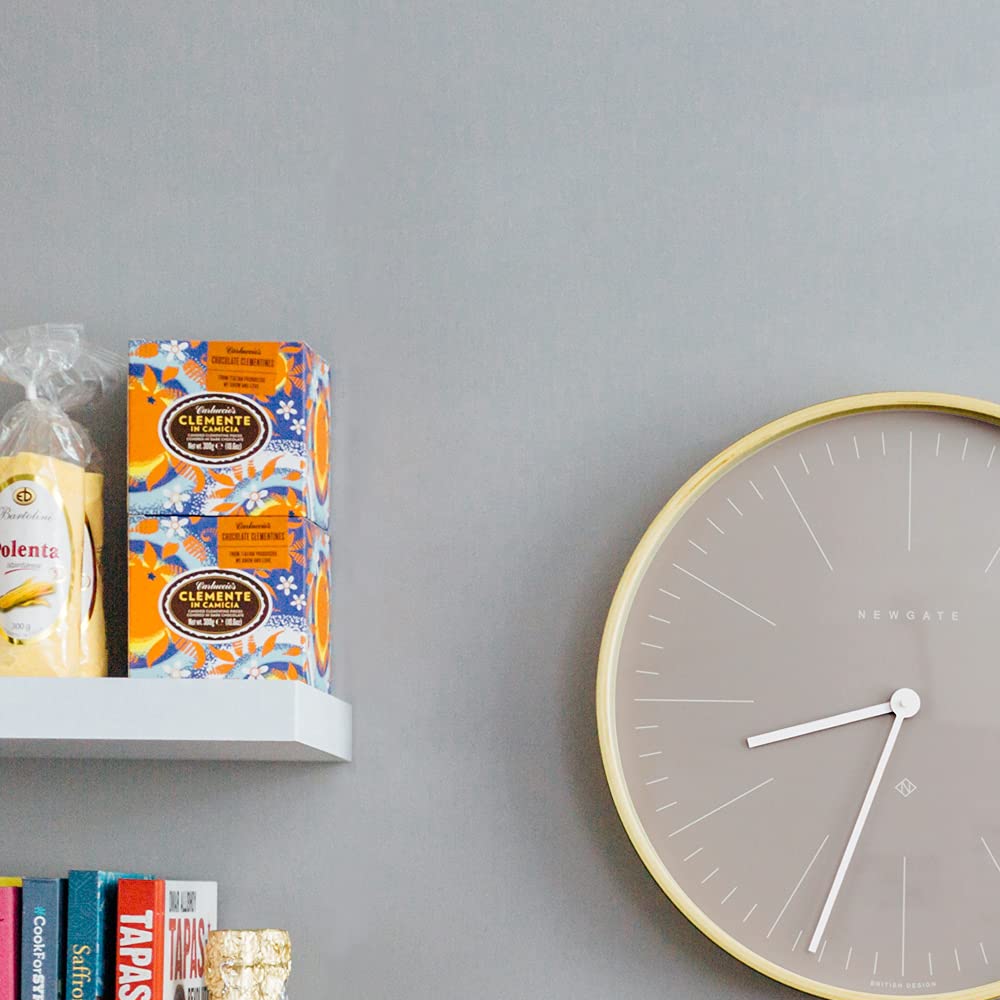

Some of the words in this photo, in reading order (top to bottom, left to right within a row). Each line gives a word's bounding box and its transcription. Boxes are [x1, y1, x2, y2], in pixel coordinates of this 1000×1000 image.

[196, 405, 236, 415] Carluccio's
[179, 415, 251, 426] CLEMENTE
[0, 539, 59, 559] olenta
[196, 581, 237, 590] Carluccio's
[179, 591, 251, 602] CLEMENTE
[857, 609, 959, 620] NEWGATE
[169, 918, 205, 980] TAPAS
[906, 981, 937, 989] DESIGN
